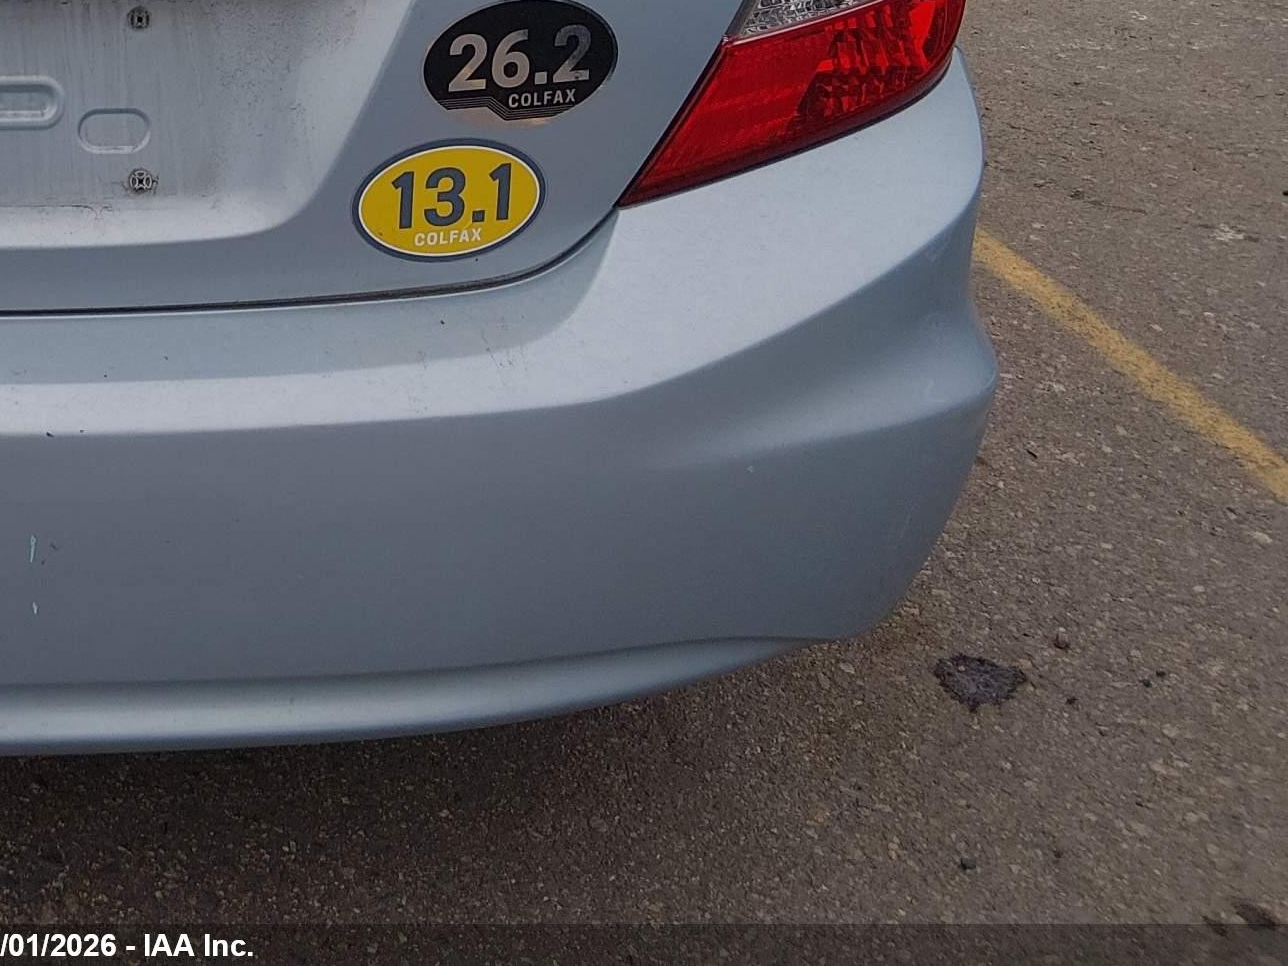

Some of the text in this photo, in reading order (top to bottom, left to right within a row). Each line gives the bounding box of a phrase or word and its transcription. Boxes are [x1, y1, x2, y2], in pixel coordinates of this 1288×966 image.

[447, 24, 593, 93] 26.2
[508, 88, 577, 109] COLFAX
[391, 162, 513, 230] 13.1
[414, 227, 483, 247] COLFAX
